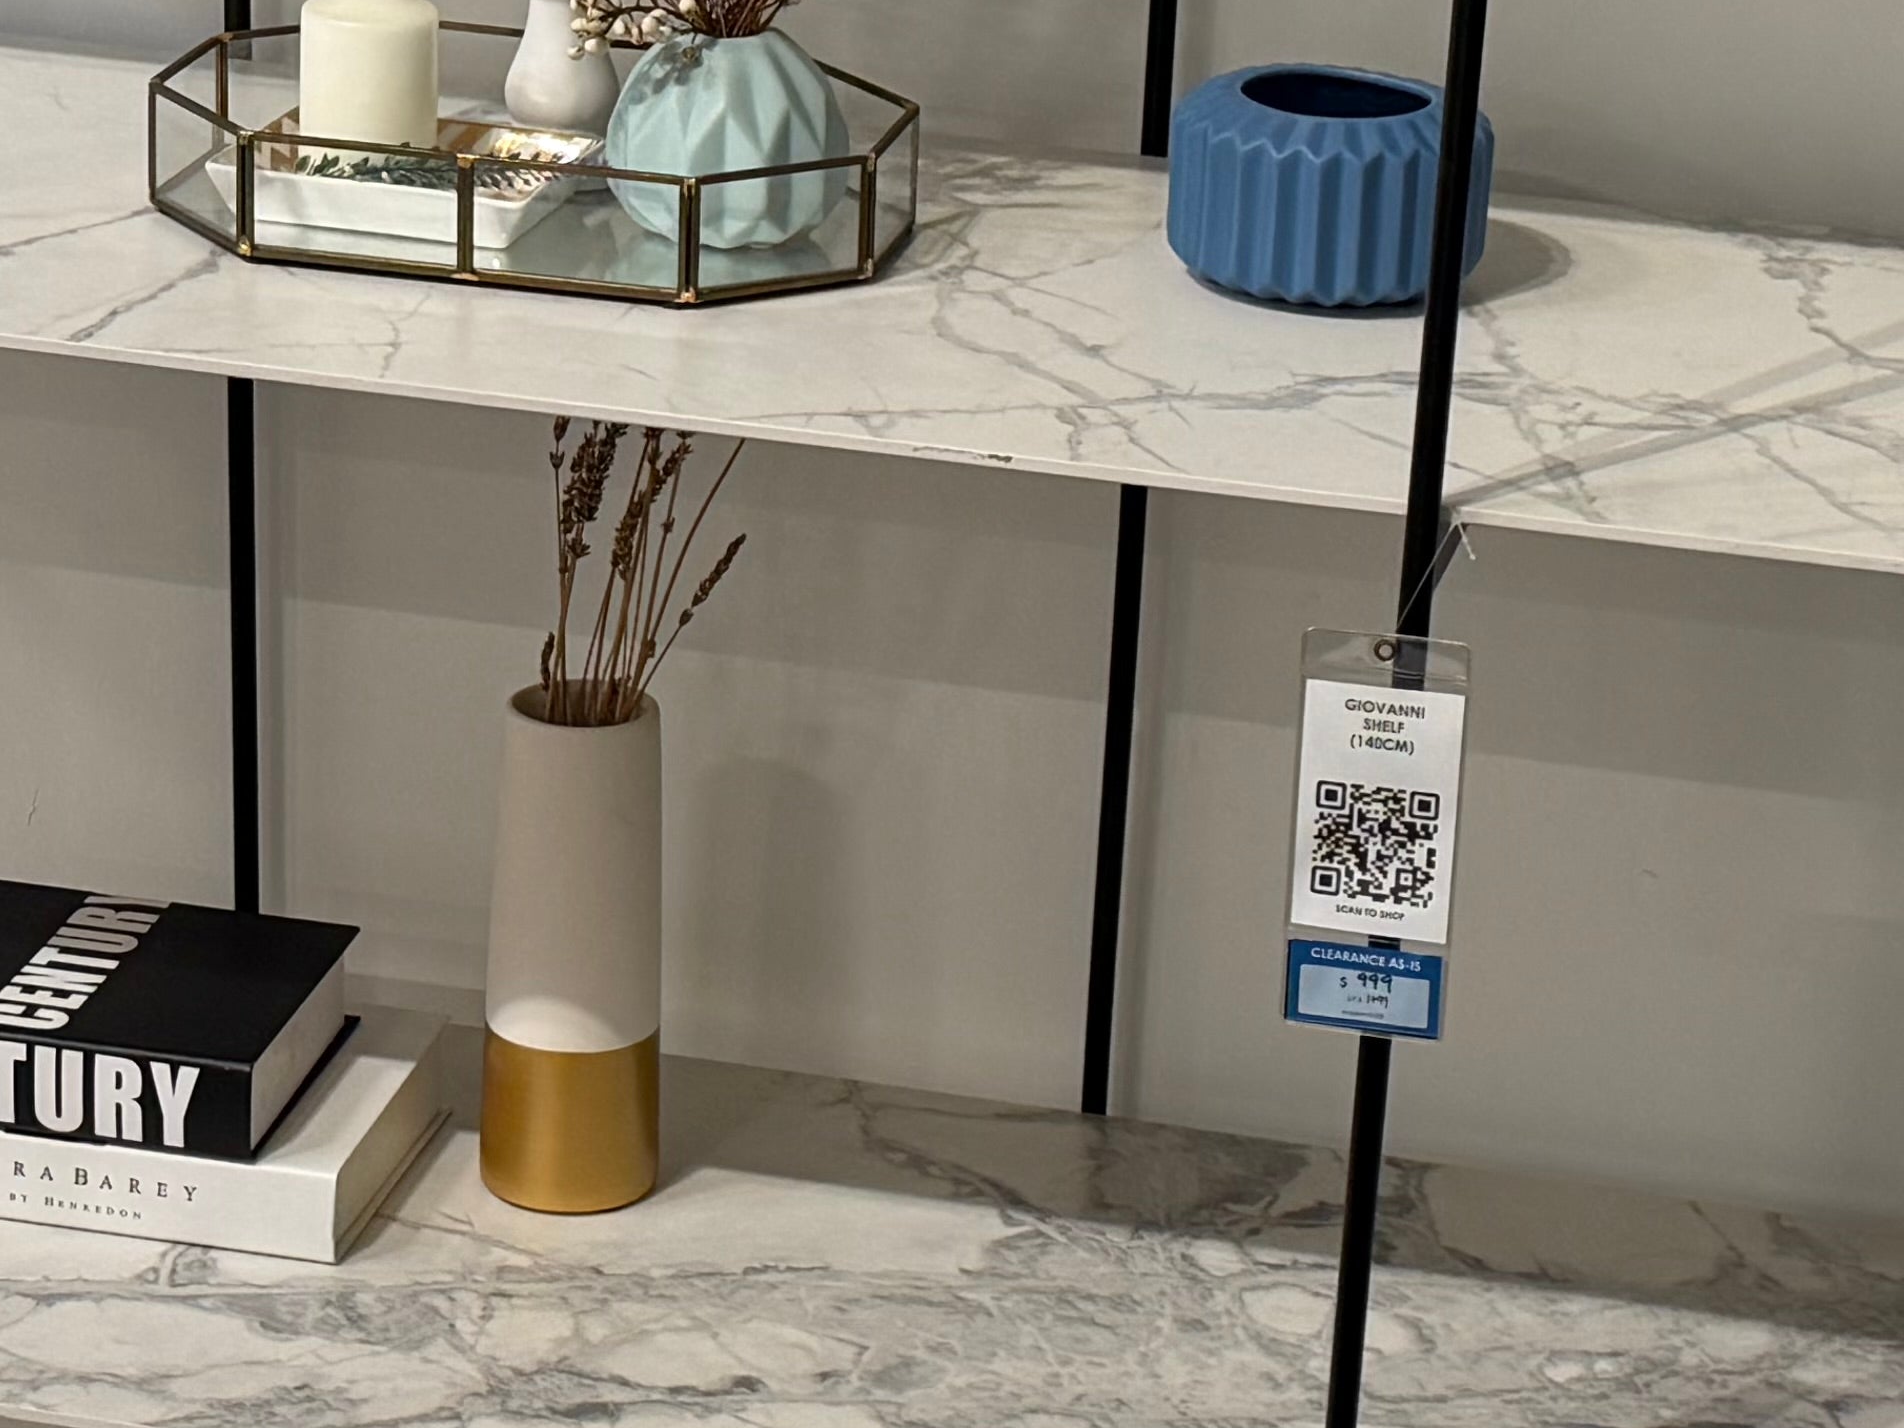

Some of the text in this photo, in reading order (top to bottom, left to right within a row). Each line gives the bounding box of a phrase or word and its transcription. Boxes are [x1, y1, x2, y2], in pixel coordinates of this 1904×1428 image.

[1345, 698, 1426, 719] GIOVANNI
[1363, 718, 1405, 734] SHELF
[1350, 734, 1415, 756] (140CM)
[1336, 904, 1405, 920] SCAN TO SHOP
[1311, 947, 1422, 973] CLEARANCE AS-IS
[1357, 972, 1393, 994] 999
[74, 1167, 198, 1202] BAREY
[9, 1193, 28, 1204] BY
[44, 1196, 142, 1221] HENREDON
